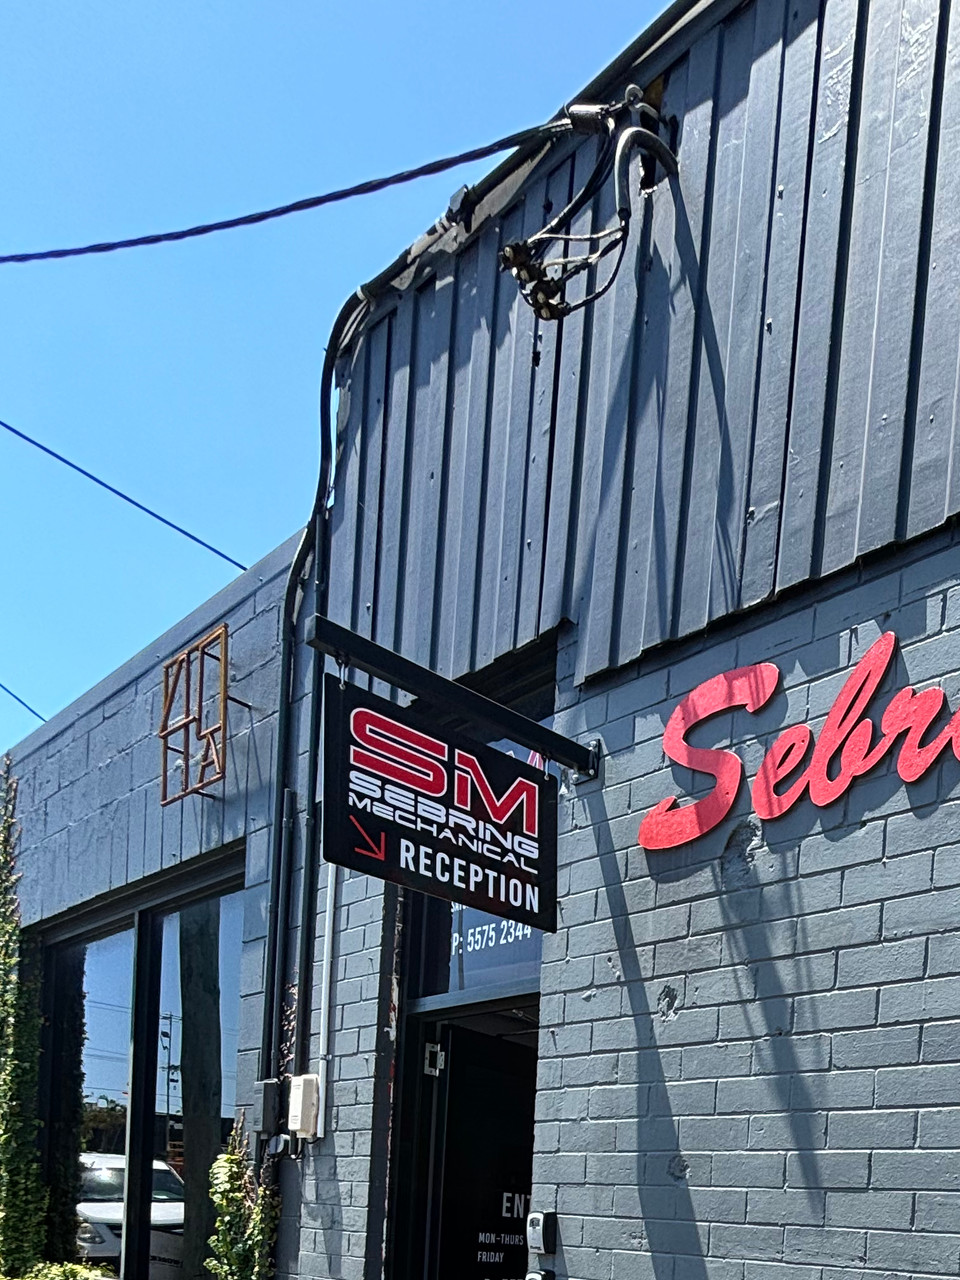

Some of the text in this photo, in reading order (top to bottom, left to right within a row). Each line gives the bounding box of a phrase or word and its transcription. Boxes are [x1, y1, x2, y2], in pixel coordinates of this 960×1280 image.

[350, 707, 539, 838] SM
[349, 770, 539, 859] SEBRING
[349, 791, 538, 874] MECHANICAL
[400, 838, 539, 913] RECEPTION
[450, 919, 532, 956] P: 5575 2344
[477, 1251, 504, 1263] FRIDAY
[478, 1232, 524, 1246] MON-THURS
